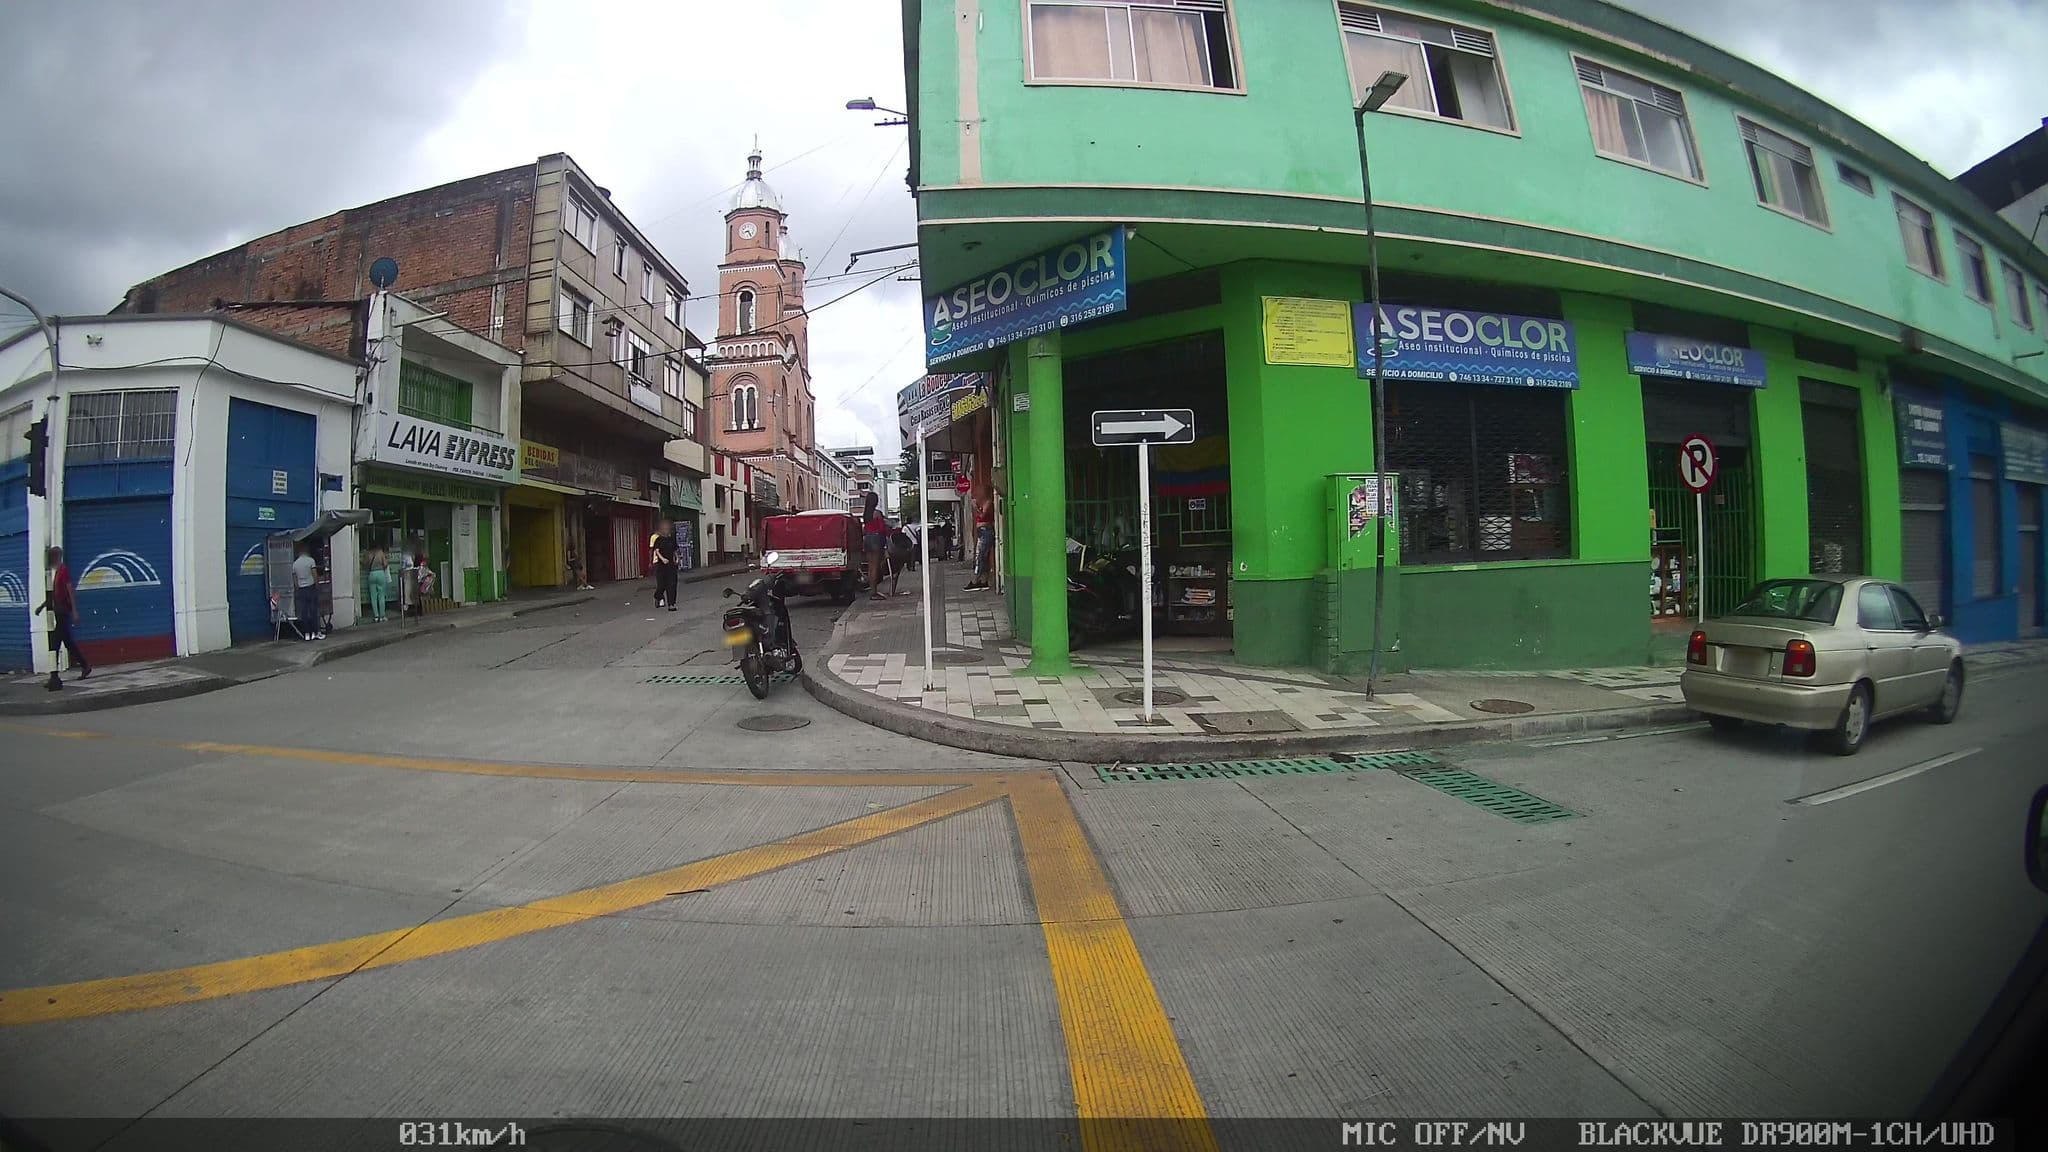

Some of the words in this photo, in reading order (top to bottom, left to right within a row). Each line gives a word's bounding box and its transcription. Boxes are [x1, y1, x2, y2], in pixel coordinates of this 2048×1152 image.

[934, 235, 1115, 326] ASEOCLOR
[952, 320, 968, 332] Aseo
[970, 301, 1018, 325] institucional
[1067, 281, 1078, 292] de
[1081, 269, 1115, 290] piscina
[929, 352, 952, 366] SERVICIO
[956, 342, 984, 357] DOMICILIO
[1015, 330, 1023, 340] 34
[1027, 326, 1038, 337] 737
[1038, 323, 1046, 332] 31
[1048, 320, 1055, 330] 01
[1070, 313, 1082, 323] 316
[1083, 309, 1096, 319] 258
[1096, 302, 1115, 315] 2189
[1369, 306, 1569, 352] ASEOCLOR
[1398, 340, 1421, 351] Aseo
[1424, 342, 1482, 355] institucional
[1531, 351, 1541, 360] de
[1543, 352, 1571, 363] piscina
[1366, 368, 1400, 378] SEVICIO
[1400, 370, 1407, 378] A
[1407, 371, 1444, 379] DOMICILIO
[1472, 374, 1480, 382] 13
[1506, 376, 1514, 384] 31
[1514, 377, 1522, 385] 01
[387, 421, 441, 457] LAVA
[443, 434, 515, 471] EXPRESS
[527, 445, 555, 463] BEBIDAS
